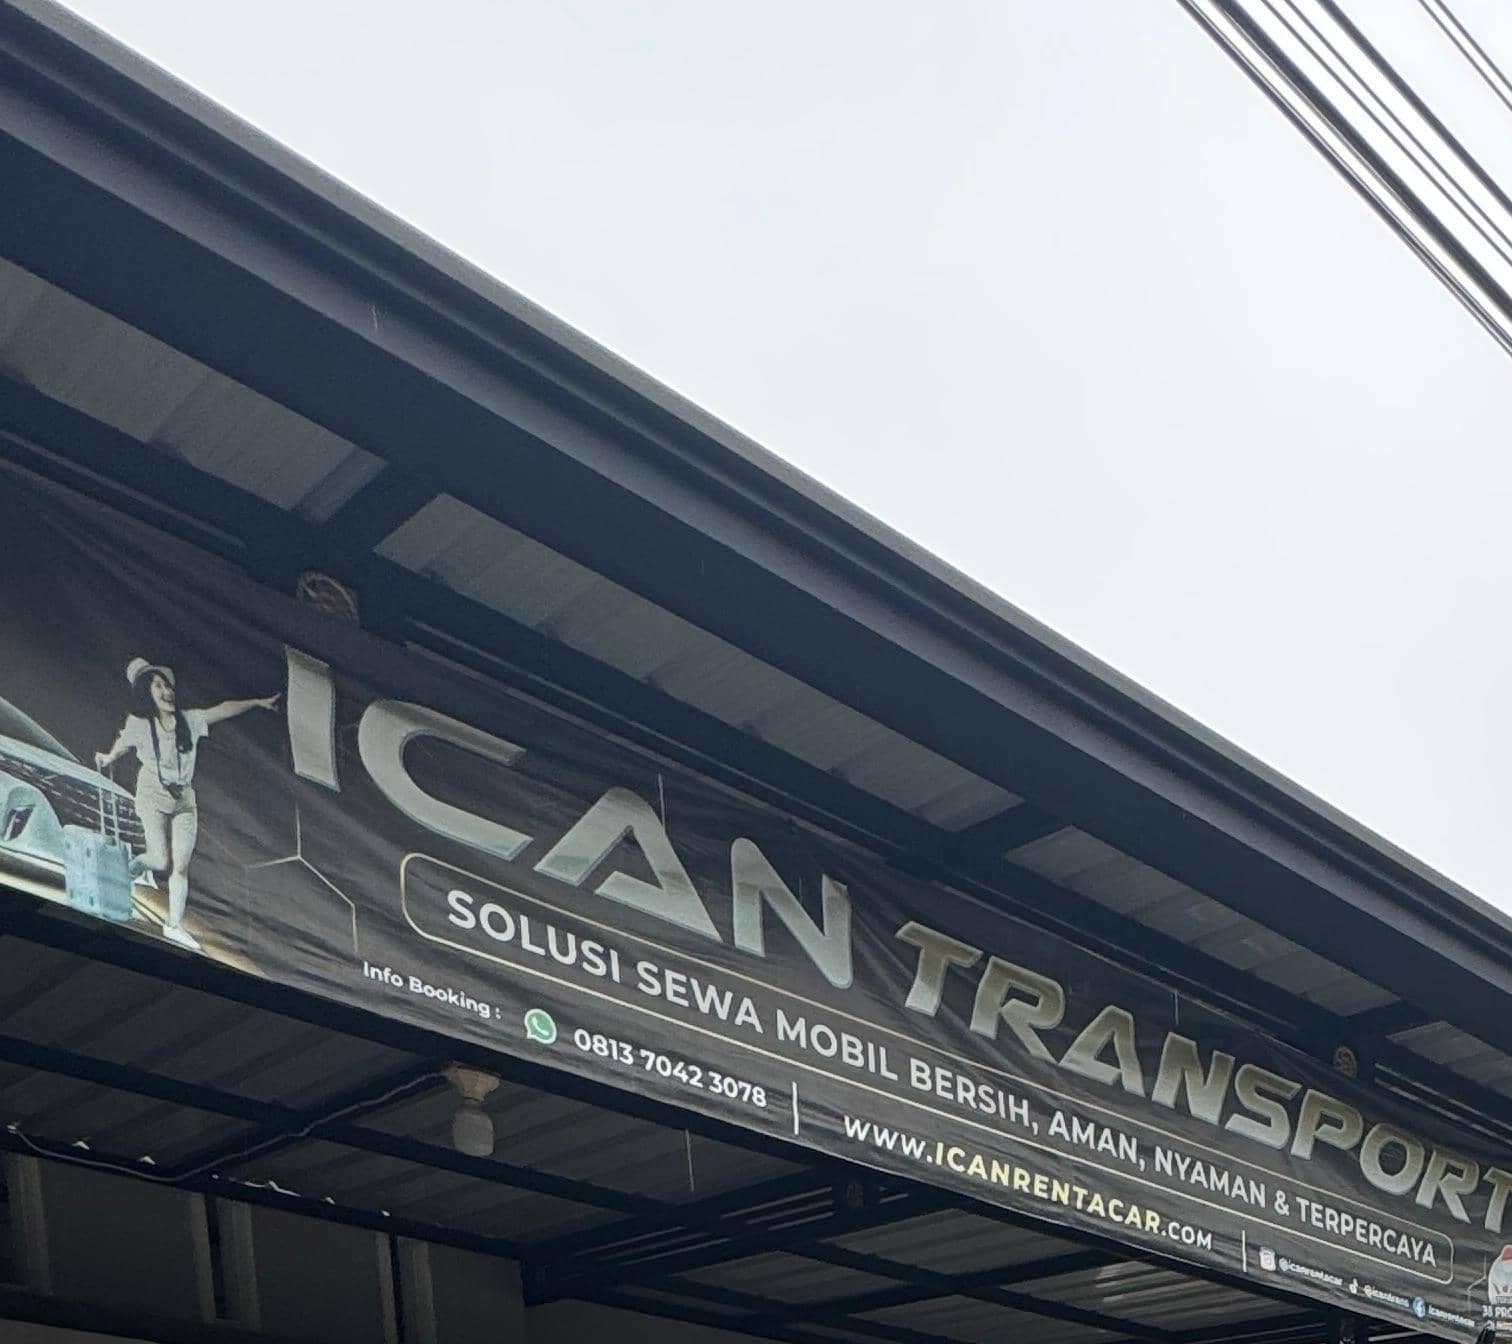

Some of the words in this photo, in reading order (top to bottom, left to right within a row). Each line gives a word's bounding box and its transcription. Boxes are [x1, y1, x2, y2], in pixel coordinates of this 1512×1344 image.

[284, 645, 854, 989] ICAN
[363, 960, 404, 988] Info
[408, 974, 491, 1020] Booking
[447, 890, 621, 985] SOLUSI
[637, 960, 764, 1035] SEWA
[775, 1008, 899, 1083] MOBIL
[909, 1056, 1040, 1137] BERSIH,
[1048, 1115, 1147, 1172] AMAN,
[1153, 1150, 1267, 1214] NYAMAN
[1273, 1194, 1291, 1215] &
[1295, 1197, 1438, 1270] TERPERCAYA
[574, 1028, 634, 1066] 0813
[640, 1048, 704, 1088] 7042
[707, 1072, 768, 1109] 3078
